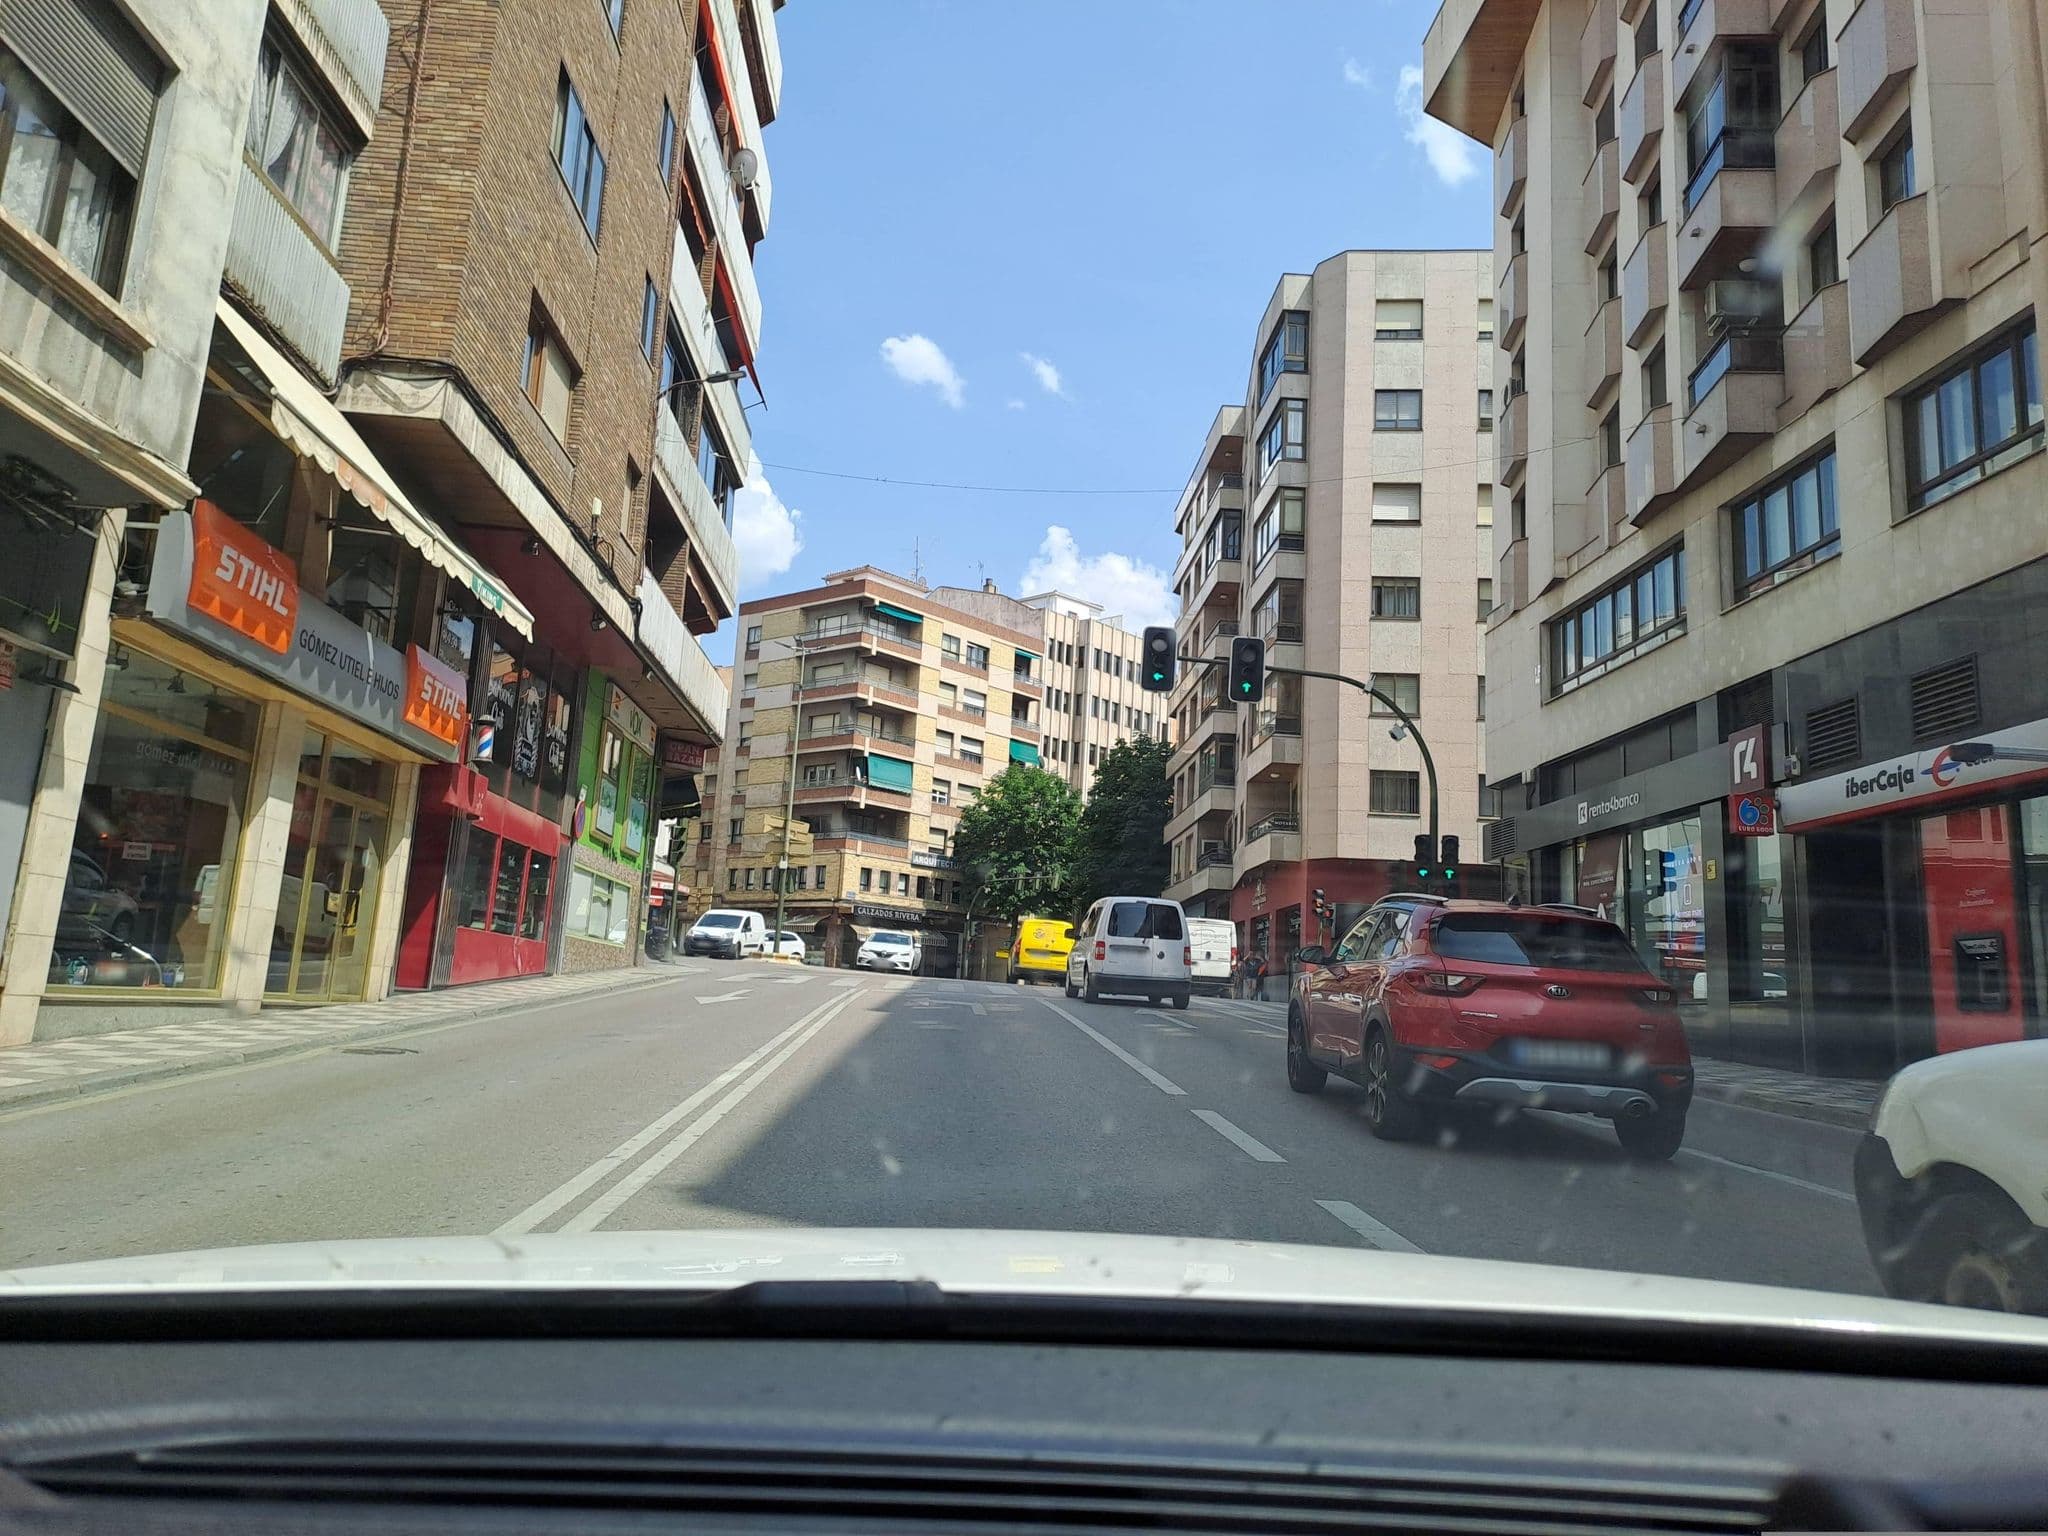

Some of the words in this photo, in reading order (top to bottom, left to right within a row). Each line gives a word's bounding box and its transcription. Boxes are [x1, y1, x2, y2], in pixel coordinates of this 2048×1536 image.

[215, 544, 289, 617] STIHL
[299, 629, 338, 665] GÓMEZ
[339, 652, 364, 681] UTIEL
[366, 668, 373, 685] E
[373, 672, 400, 700] HIJOS
[420, 675, 462, 721] STIHL
[1845, 764, 1915, 798] iberCaja
[1588, 792, 1640, 818] renta4banco
[914, 855, 961, 869] ARQUITECTU
[857, 907, 893, 918] CALZADOS
[894, 911, 920, 921] RIVERA
[1550, 986, 1568, 997] KIA
